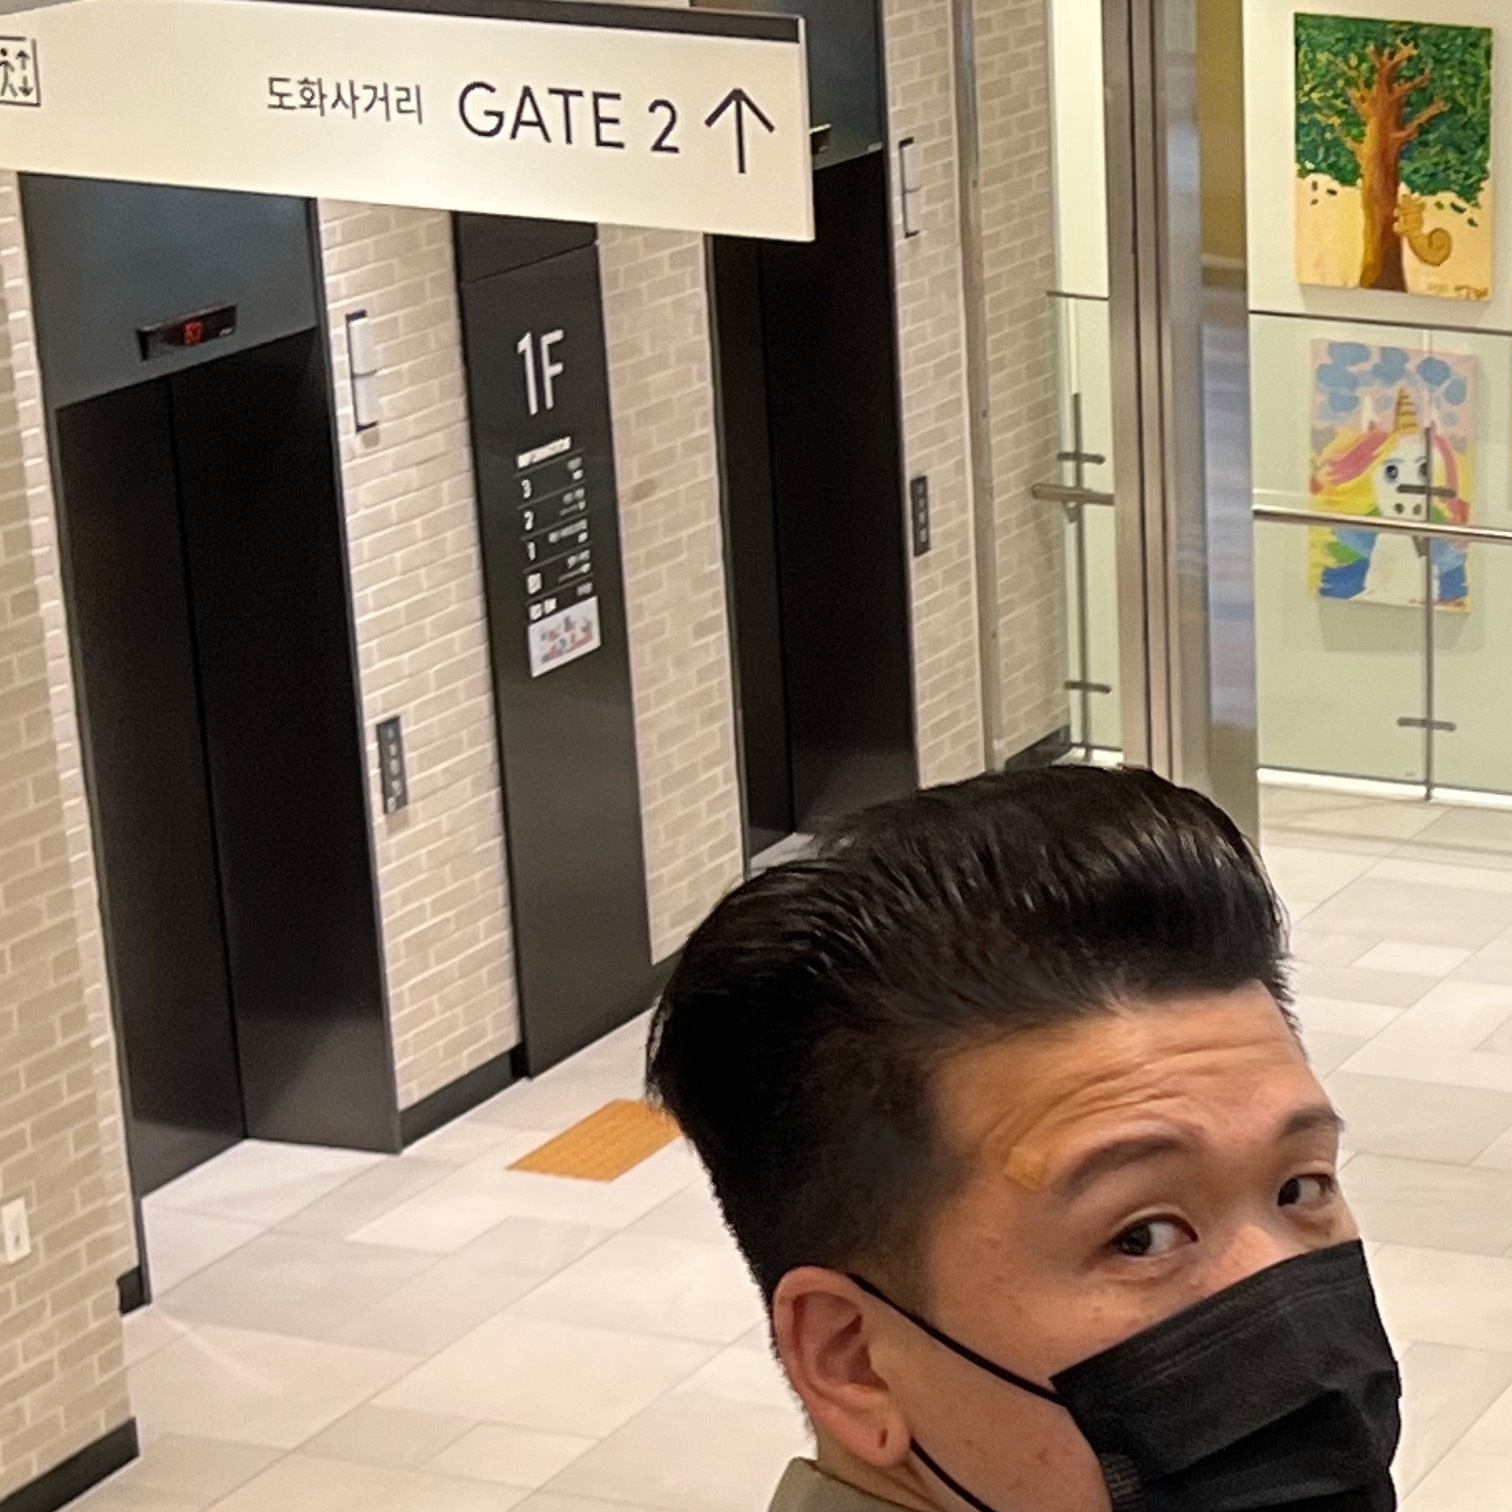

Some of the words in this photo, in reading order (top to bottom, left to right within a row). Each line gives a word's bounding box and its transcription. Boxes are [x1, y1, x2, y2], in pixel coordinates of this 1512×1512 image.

[267, 77, 423, 124] 도화사거리
[458, 81, 625, 149] GATE
[648, 99, 680, 154] 2
[516, 328, 565, 416] 1F
